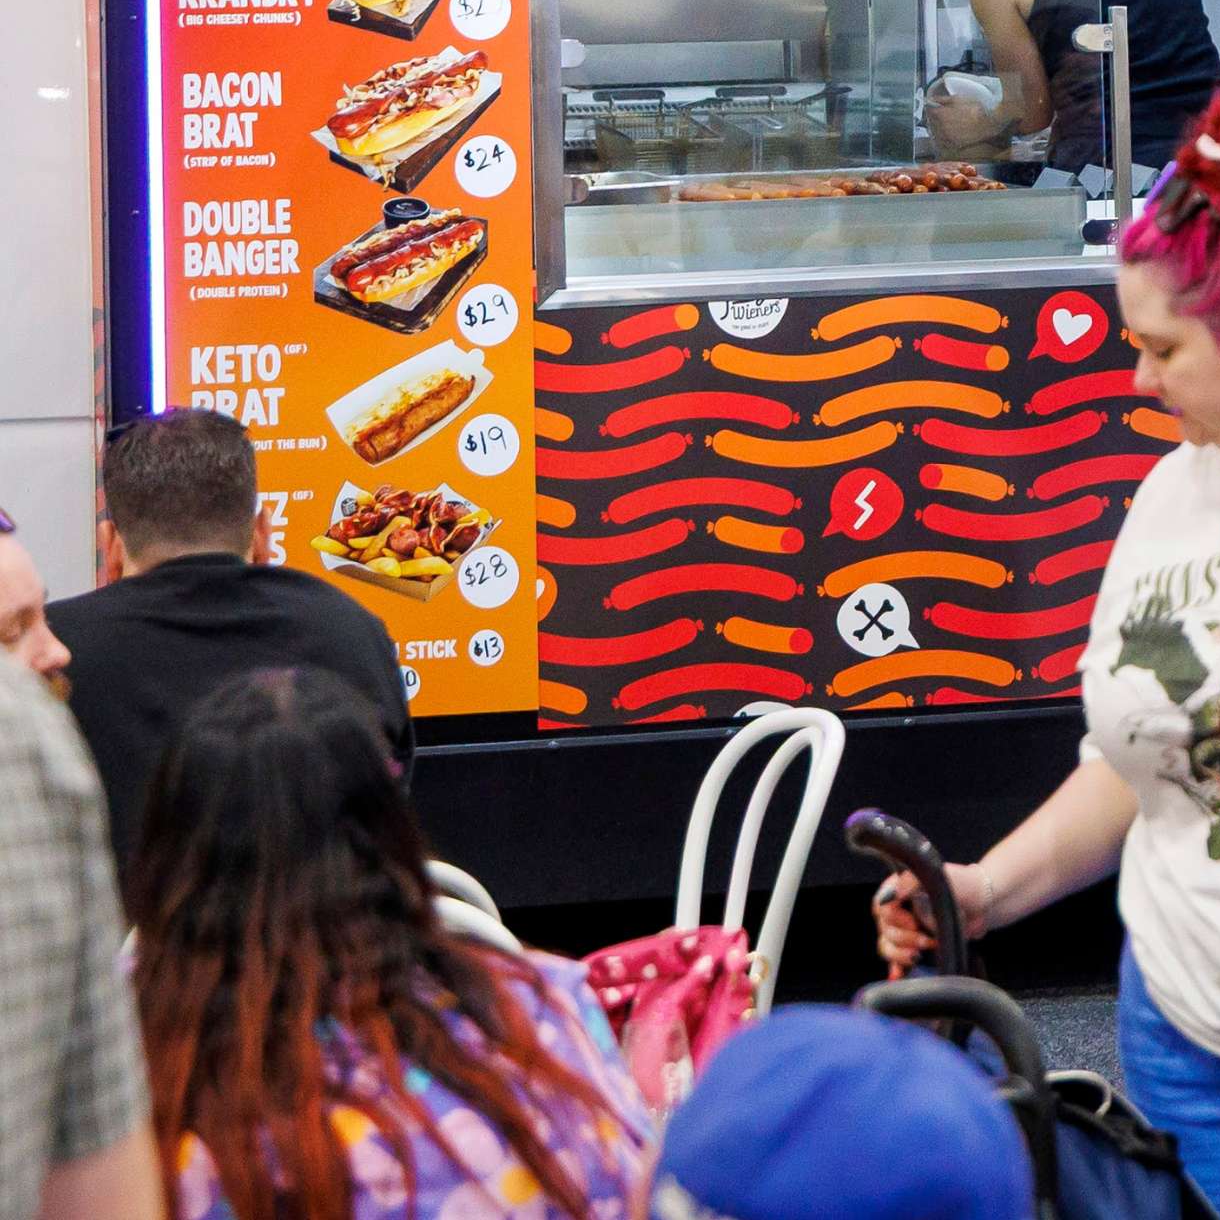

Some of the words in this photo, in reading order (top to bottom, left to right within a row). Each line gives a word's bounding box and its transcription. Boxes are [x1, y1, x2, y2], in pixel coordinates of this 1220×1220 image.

[183, 71, 282, 109] BACON
[183, 112, 259, 149] BRAT
[184, 154, 218, 169] (STRIP
[220, 156, 233, 167] OF
[236, 152, 276, 167] BACON)
[464, 147, 504, 172] $24
[183, 198, 292, 237] DOUBLE
[184, 239, 301, 277] BANGER
[464, 294, 509, 327] $29
[191, 344, 282, 385] KETO
[277, 438, 296, 450] THE
[465, 426, 508, 455] $19
[465, 554, 508, 587] $28
[405, 639, 458, 660] STICK
[474, 637, 501, 658] $13
